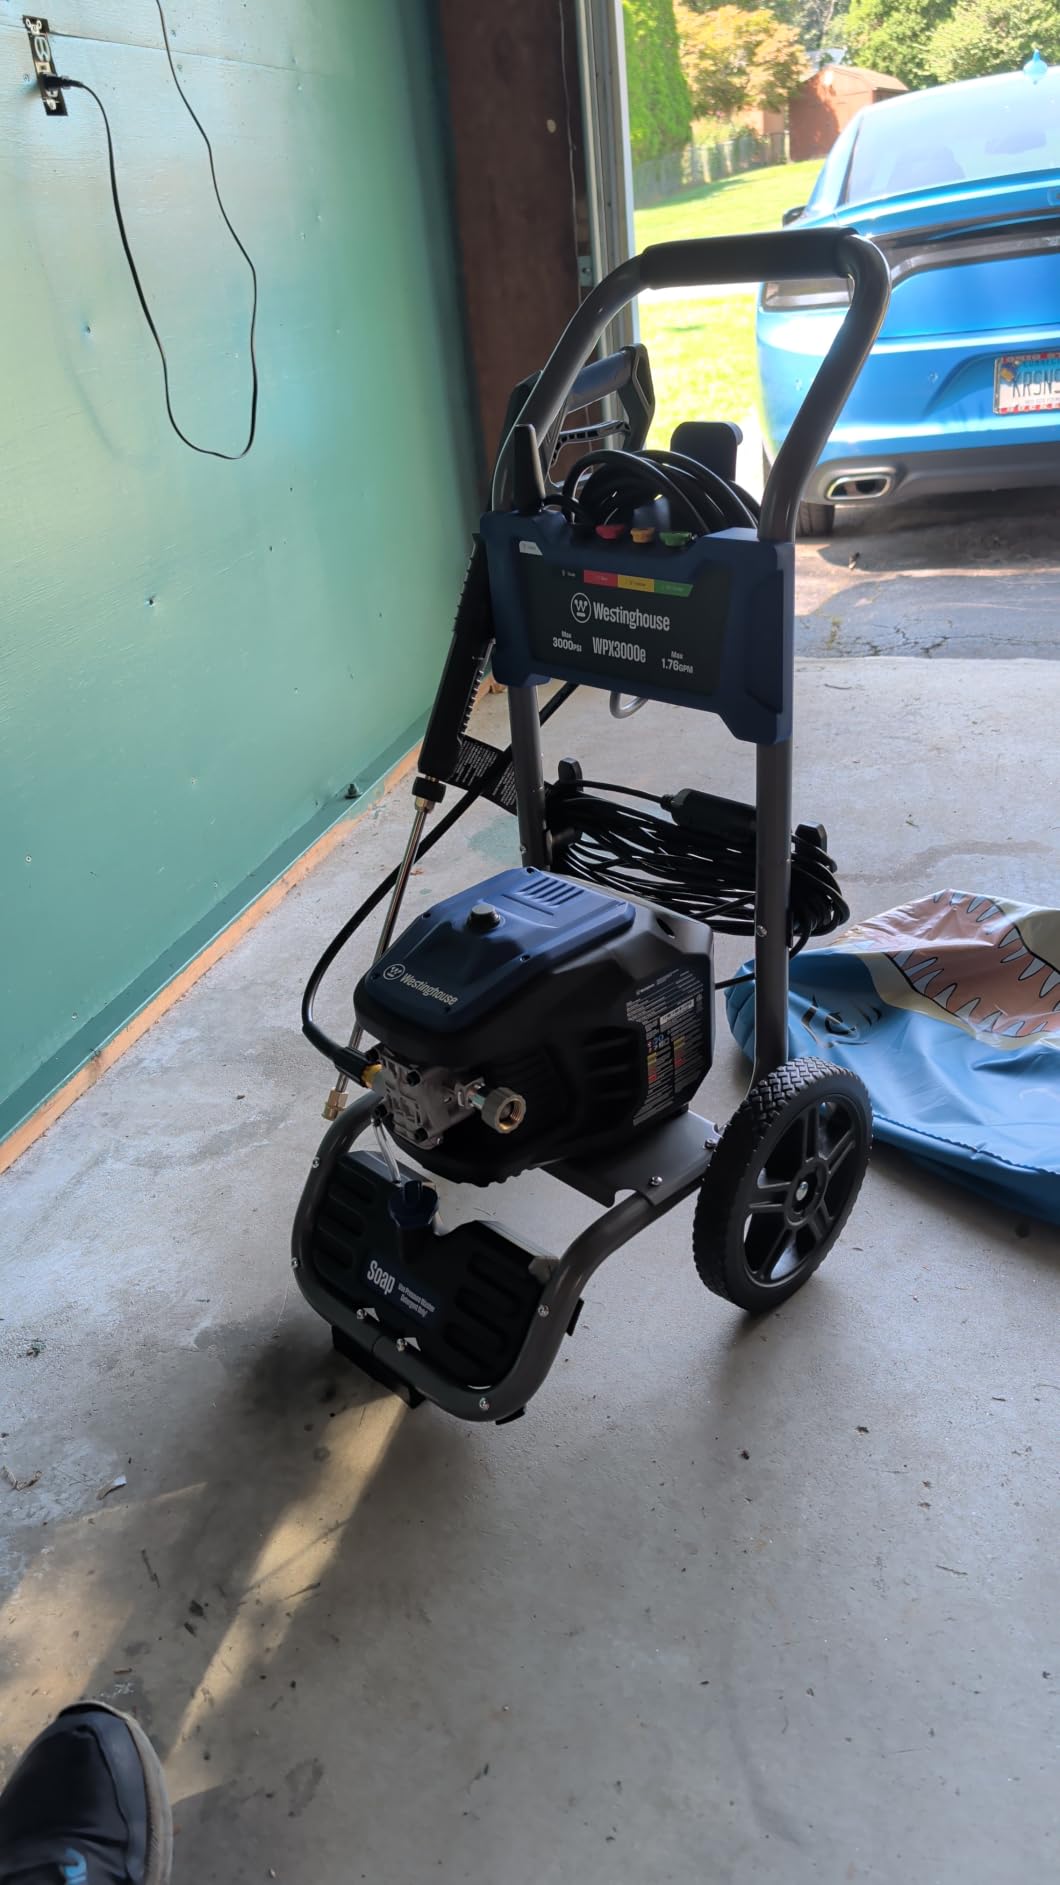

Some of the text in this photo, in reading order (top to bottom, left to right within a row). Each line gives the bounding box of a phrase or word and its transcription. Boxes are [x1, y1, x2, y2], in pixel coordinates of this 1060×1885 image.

[593, 601, 670, 631] Westinghouse
[592, 636, 646, 663] WPX3000e
[400, 973, 458, 1005] Westinghouse
[367, 1260, 395, 1295] Soap
